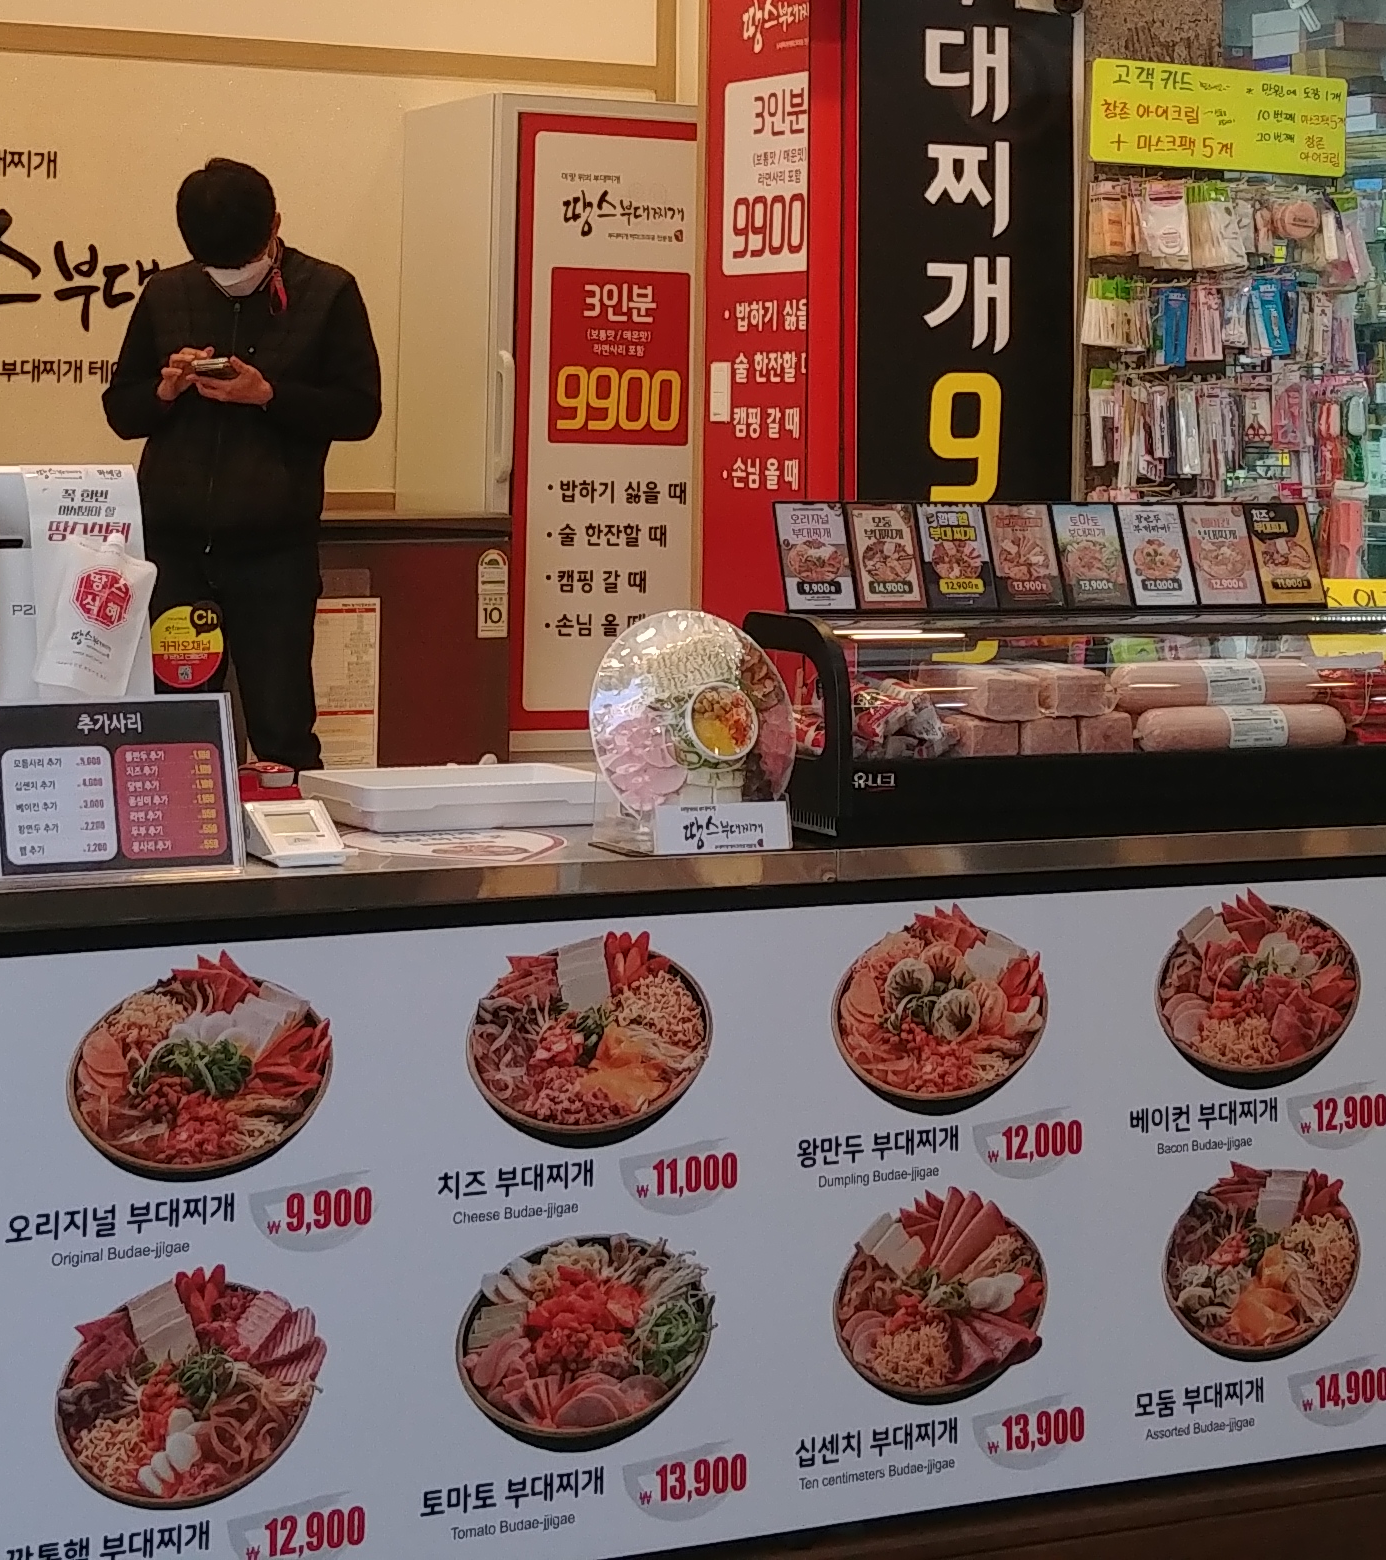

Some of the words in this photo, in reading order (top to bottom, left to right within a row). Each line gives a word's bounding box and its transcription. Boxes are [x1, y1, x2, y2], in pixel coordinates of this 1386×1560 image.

[1112, 63, 1155, 90] 고객
[1160, 68, 1195, 91] 카드
[1136, 134, 1197, 158] 마스크팩
[732, 192, 806, 260] 9900
[583, 283, 658, 323] 3인분
[556, 365, 682, 432] 9900
[731, 456, 761, 490] 손님
[764, 457, 781, 490] 올
[784, 458, 799, 491] 때
[559, 480, 616, 507] 밥하기
[623, 480, 663, 507] 싫을
[668, 480, 688, 506] 때
[557, 523, 578, 547] 술
[584, 523, 642, 548] 한잔할
[648, 524, 667, 548] 때
[76, 712, 144, 735] 추가사리
[1128, 1104, 1192, 1135] 베이컨
[1197, 1096, 1279, 1131] 부대찌개
[796, 1133, 865, 1169] 왕만두
[871, 1123, 960, 1161] 부대찌개
[1001, 1118, 1083, 1163] 12,000
[437, 1170, 489, 1201] 치즈
[495, 1159, 595, 1195] 부대찌개
[653, 1151, 738, 1198] 11,000
[5, 1203, 117, 1244] 오리지널
[125, 1192, 236, 1232] 부대찌개
[285, 1186, 373, 1235] 9,900
[451, 1206, 501, 1225] Cheese
[51, 1249, 104, 1268] Original
[1133, 1388, 1177, 1419] 모둠
[1181, 1376, 1265, 1412] 부대찌개
[420, 1482, 498, 1519] 토마토
[504, 1465, 605, 1506] 부대찌개
[655, 1452, 748, 1503] 13,900
